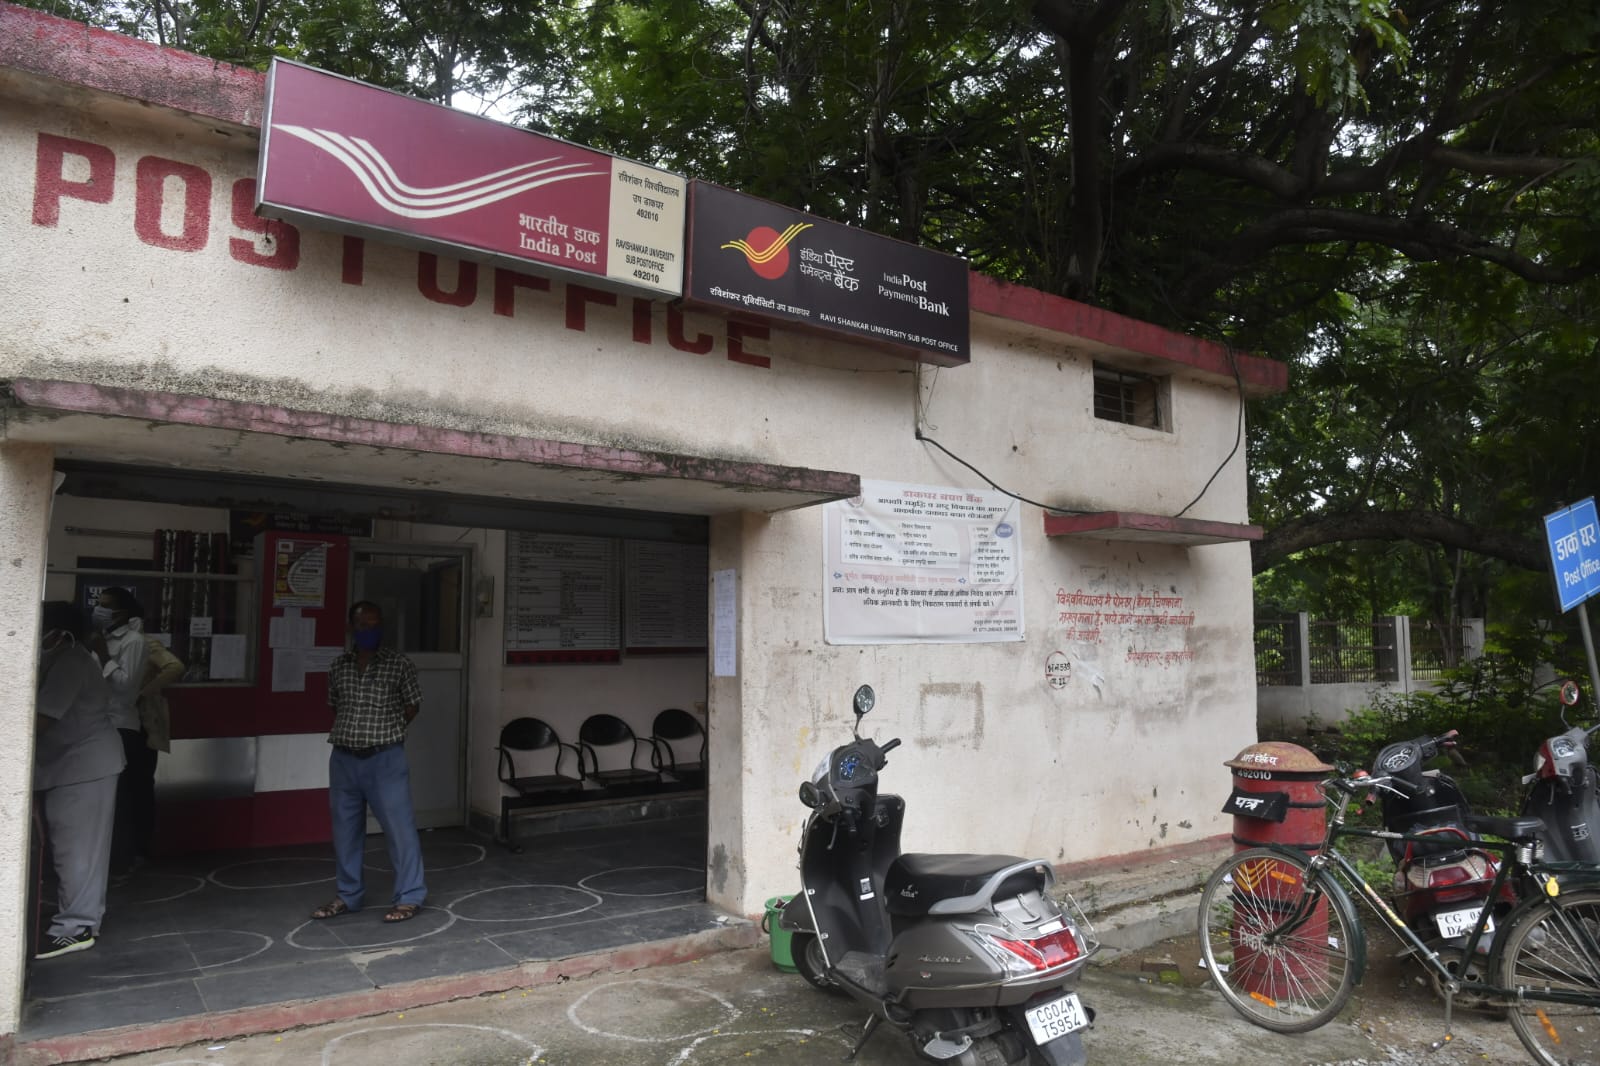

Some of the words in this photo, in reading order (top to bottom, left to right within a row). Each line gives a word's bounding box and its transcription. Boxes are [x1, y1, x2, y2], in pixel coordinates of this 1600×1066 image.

[636, 208, 659, 222] 492010
[519, 212, 569, 239] भारतीय
[573, 226, 601, 246] डाक
[520, 232, 561, 257] India
[565, 242, 598, 265] Post
[625, 254, 636, 265] SUB
[649, 247, 675, 262] UNIVERSITY
[799, 247, 823, 264] इंडिया
[824, 249, 855, 272] पोस्ट
[633, 269, 660, 283] 492010
[832, 268, 860, 292] बैंक
[883, 271, 902, 287] India
[902, 273, 928, 293] Post
[878, 284, 919, 306] Payments
[919, 295, 950, 318] Bank
[820, 312, 836, 325] RAVI
[837, 316, 870, 331] SHANKAR
[870, 322, 907, 340] UNIVERSITY
[907, 333, 920, 343] SUB
[921, 336, 938, 347] POST
[938, 340, 959, 353] OFFICE
[1555, 531, 1580, 561] डाक
[1579, 523, 1597, 547] घर
[1563, 566, 1581, 588] Post
[1235, 796, 1264, 811] पत्र
[1036, 998, 1075, 1023] CG04M
[1042, 1012, 1081, 1038] T5954
